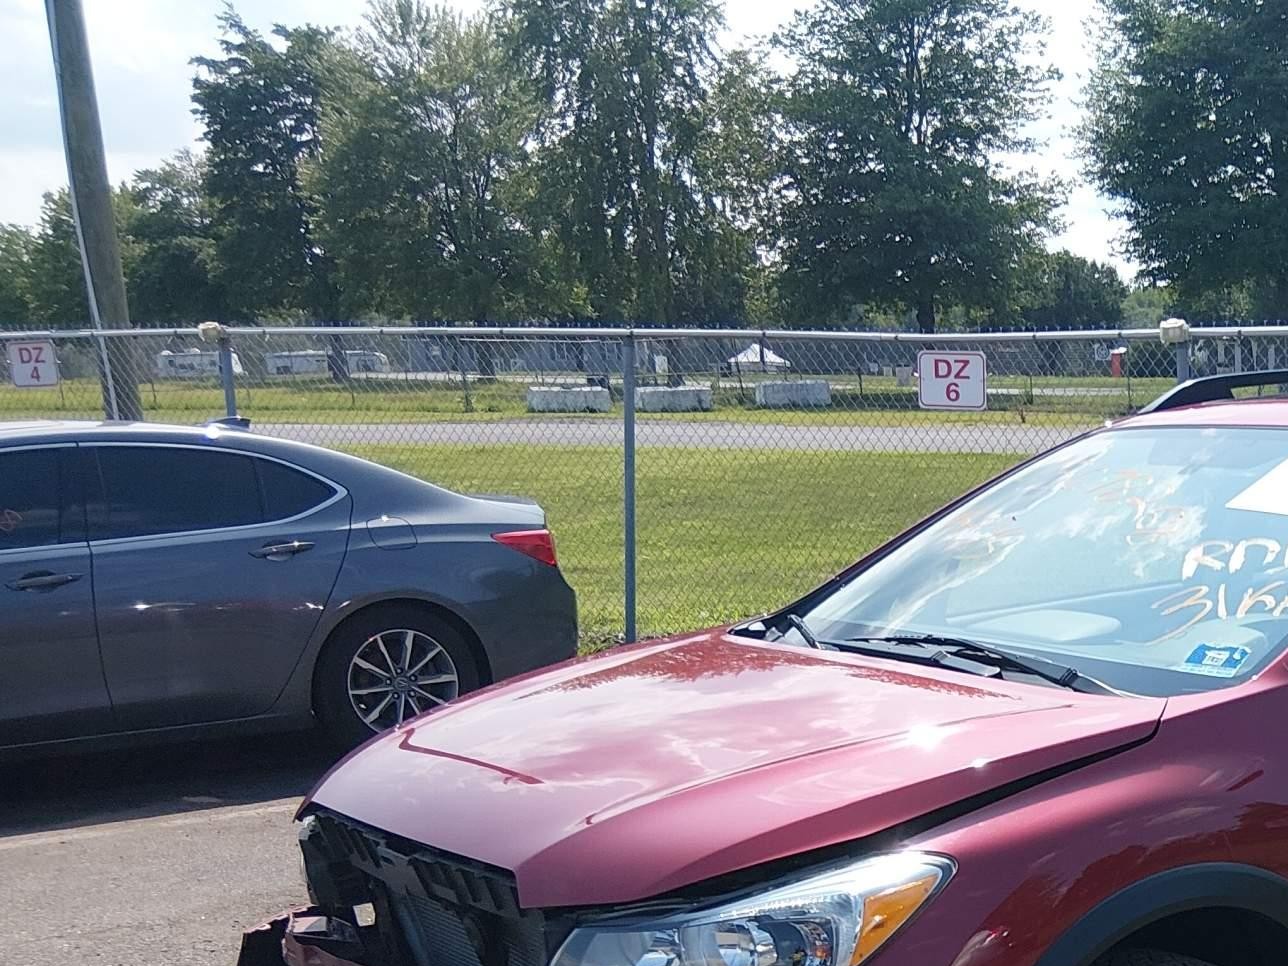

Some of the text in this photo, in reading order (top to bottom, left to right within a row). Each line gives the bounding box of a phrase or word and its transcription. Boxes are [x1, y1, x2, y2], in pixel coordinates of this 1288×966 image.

[18, 346, 46, 364] DZ
[31, 365, 41, 382] 4
[933, 358, 971, 379] DZ
[945, 382, 960, 402] 6
